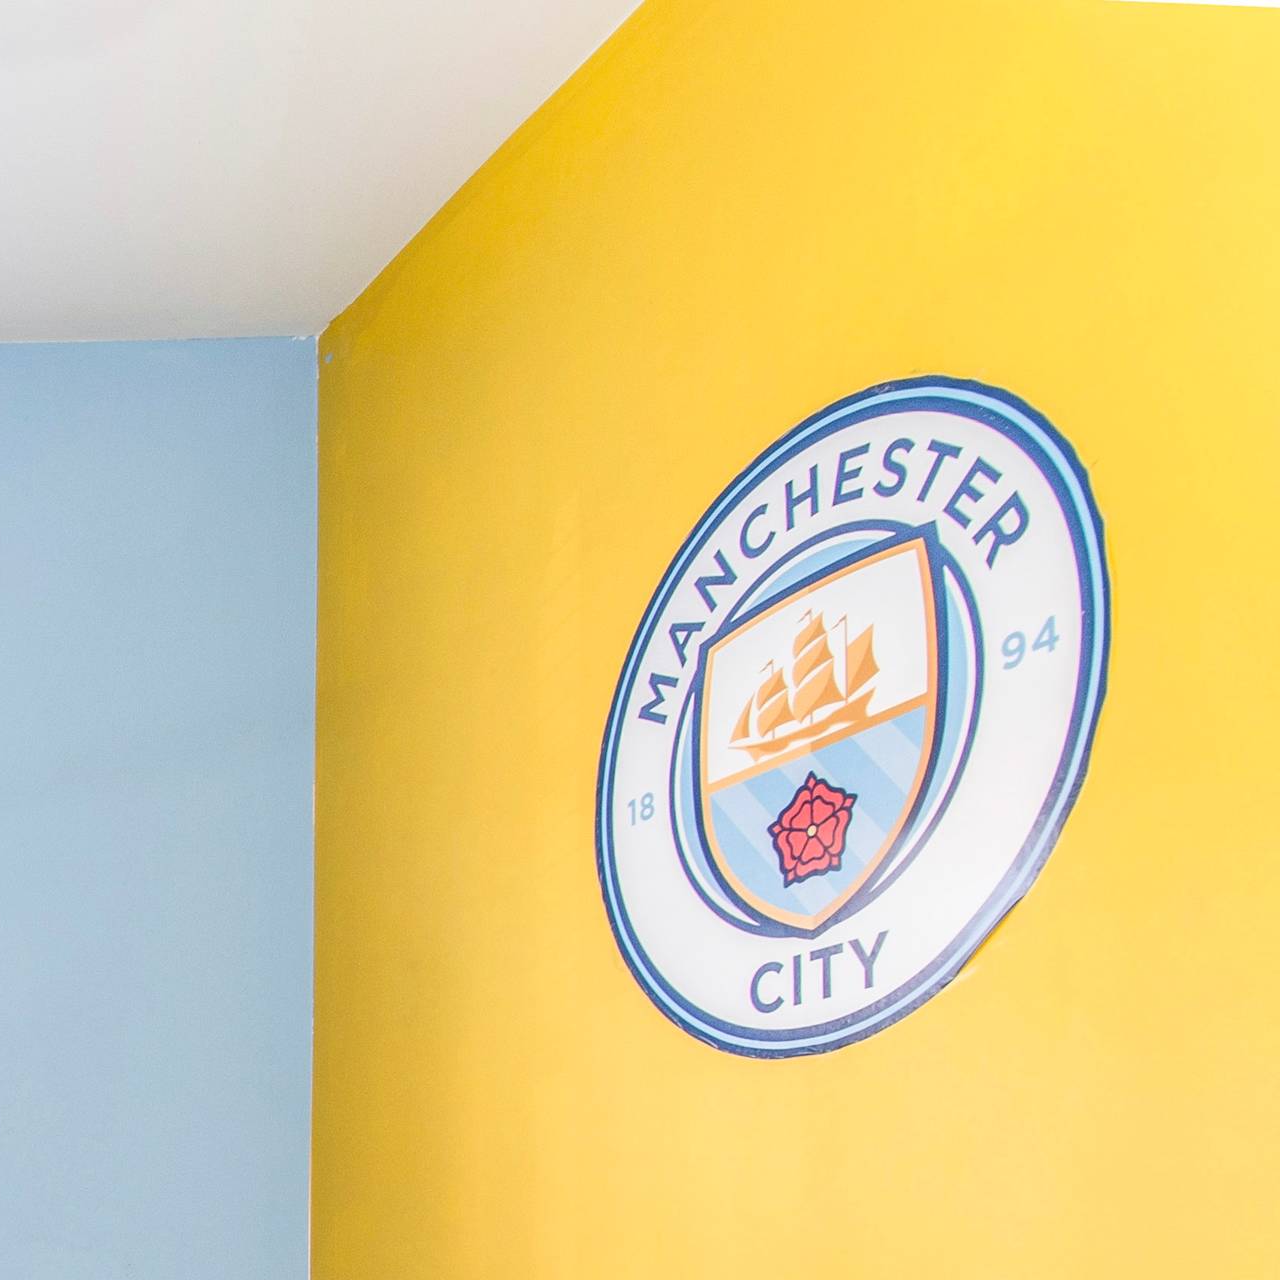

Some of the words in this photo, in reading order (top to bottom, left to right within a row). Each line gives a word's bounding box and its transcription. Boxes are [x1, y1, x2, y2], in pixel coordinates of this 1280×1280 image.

[637, 437, 1031, 725] MANCHESTER
[1000, 614, 1060, 671] 94
[626, 792, 655, 828] 18
[749, 930, 890, 1014] CITY
